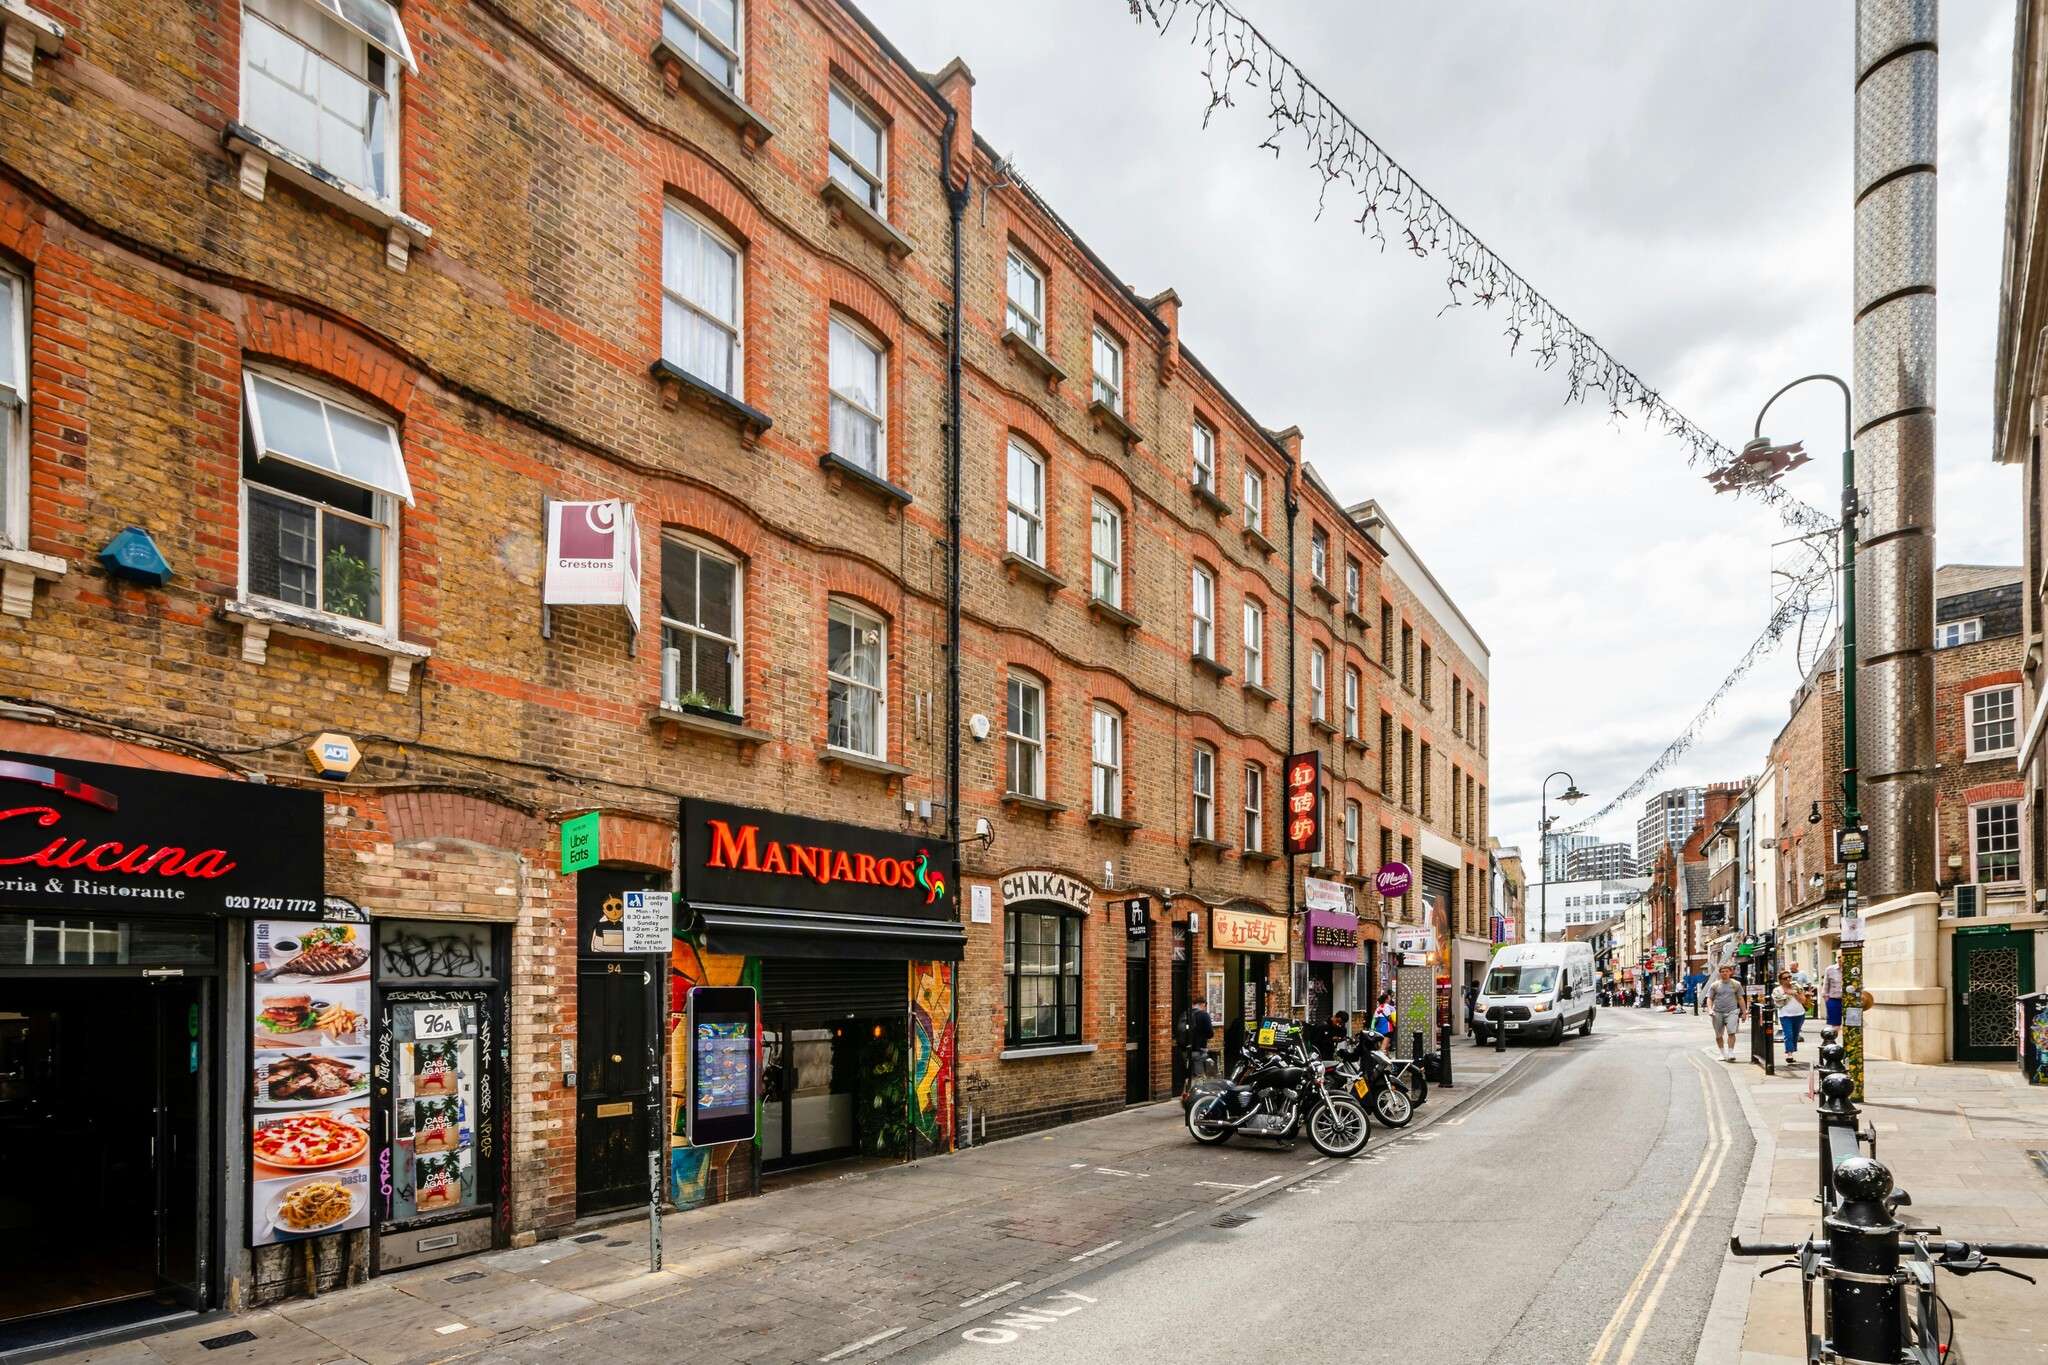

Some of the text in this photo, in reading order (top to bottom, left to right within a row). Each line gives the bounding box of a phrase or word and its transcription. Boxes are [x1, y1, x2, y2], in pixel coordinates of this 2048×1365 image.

[560, 560, 613, 568] Crestons
[325, 746, 347, 759] ADT
[571, 834, 589, 848] Uber
[571, 849, 589, 863] Eats
[706, 820, 917, 889] MANJAROS
[45, 877, 65, 894] &
[73, 879, 185, 900] Ristorante
[225, 896, 316, 912] 020 7247 7772
[258, 923, 270, 959] grill fish
[1315, 926, 1358, 948] MASALA
[607, 964, 622, 974] 94
[424, 1014, 453, 1033] 96A
[424, 1060, 448, 1068] CASA
[425, 1116, 449, 1125] CASA
[341, 1173, 367, 1186] pasta
[426, 1172, 450, 1181] CASA
[962, 1289, 1098, 1344] ONLY
